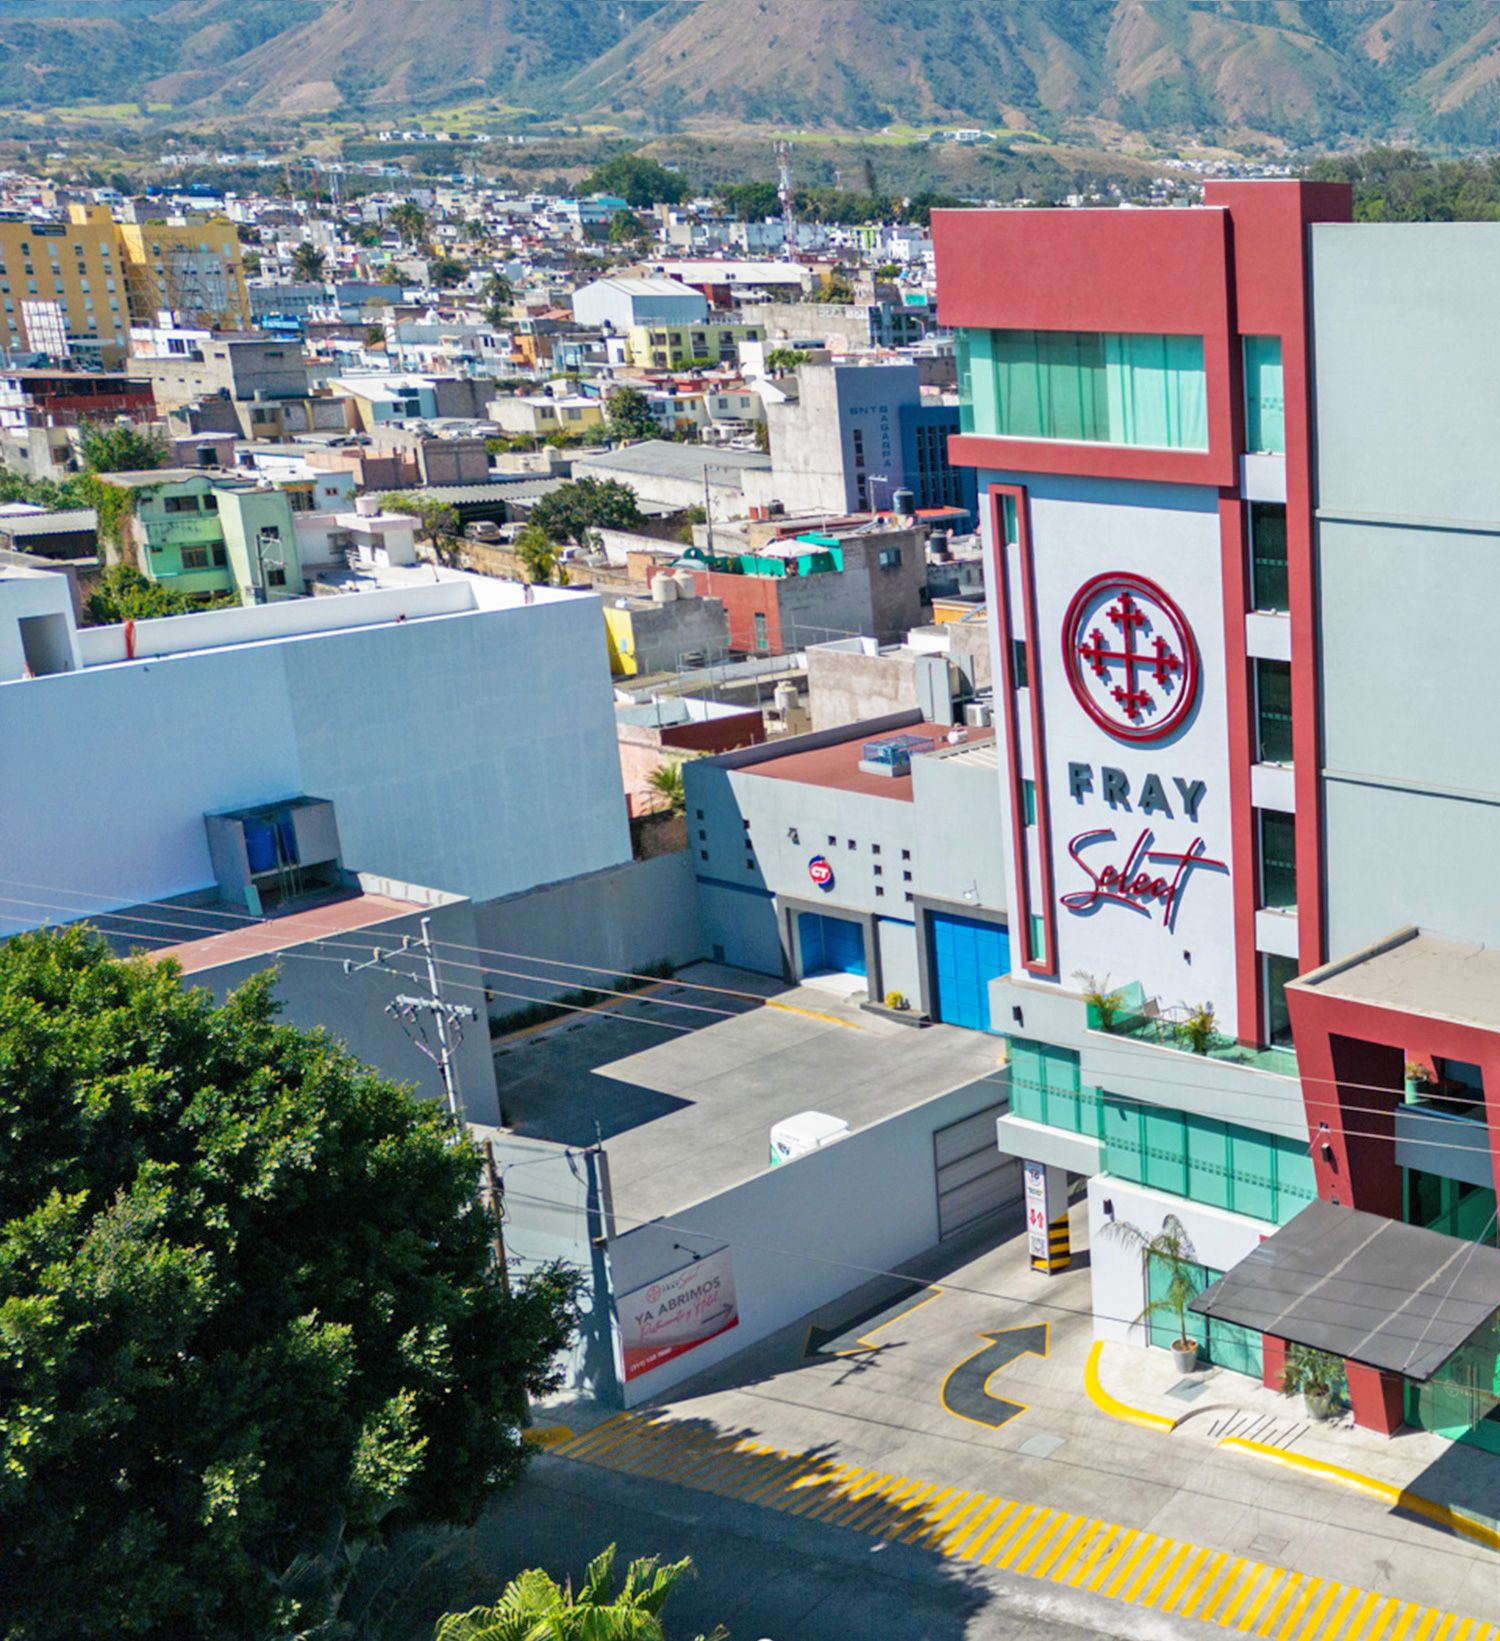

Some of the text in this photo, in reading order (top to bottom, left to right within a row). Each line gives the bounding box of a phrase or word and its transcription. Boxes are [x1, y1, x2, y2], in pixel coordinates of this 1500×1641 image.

[1068, 761, 1207, 821] FRAY
[1060, 827, 1228, 930] Select
[634, 1310, 654, 1326] YA
[658, 1275, 721, 1316] ABRIMOS
